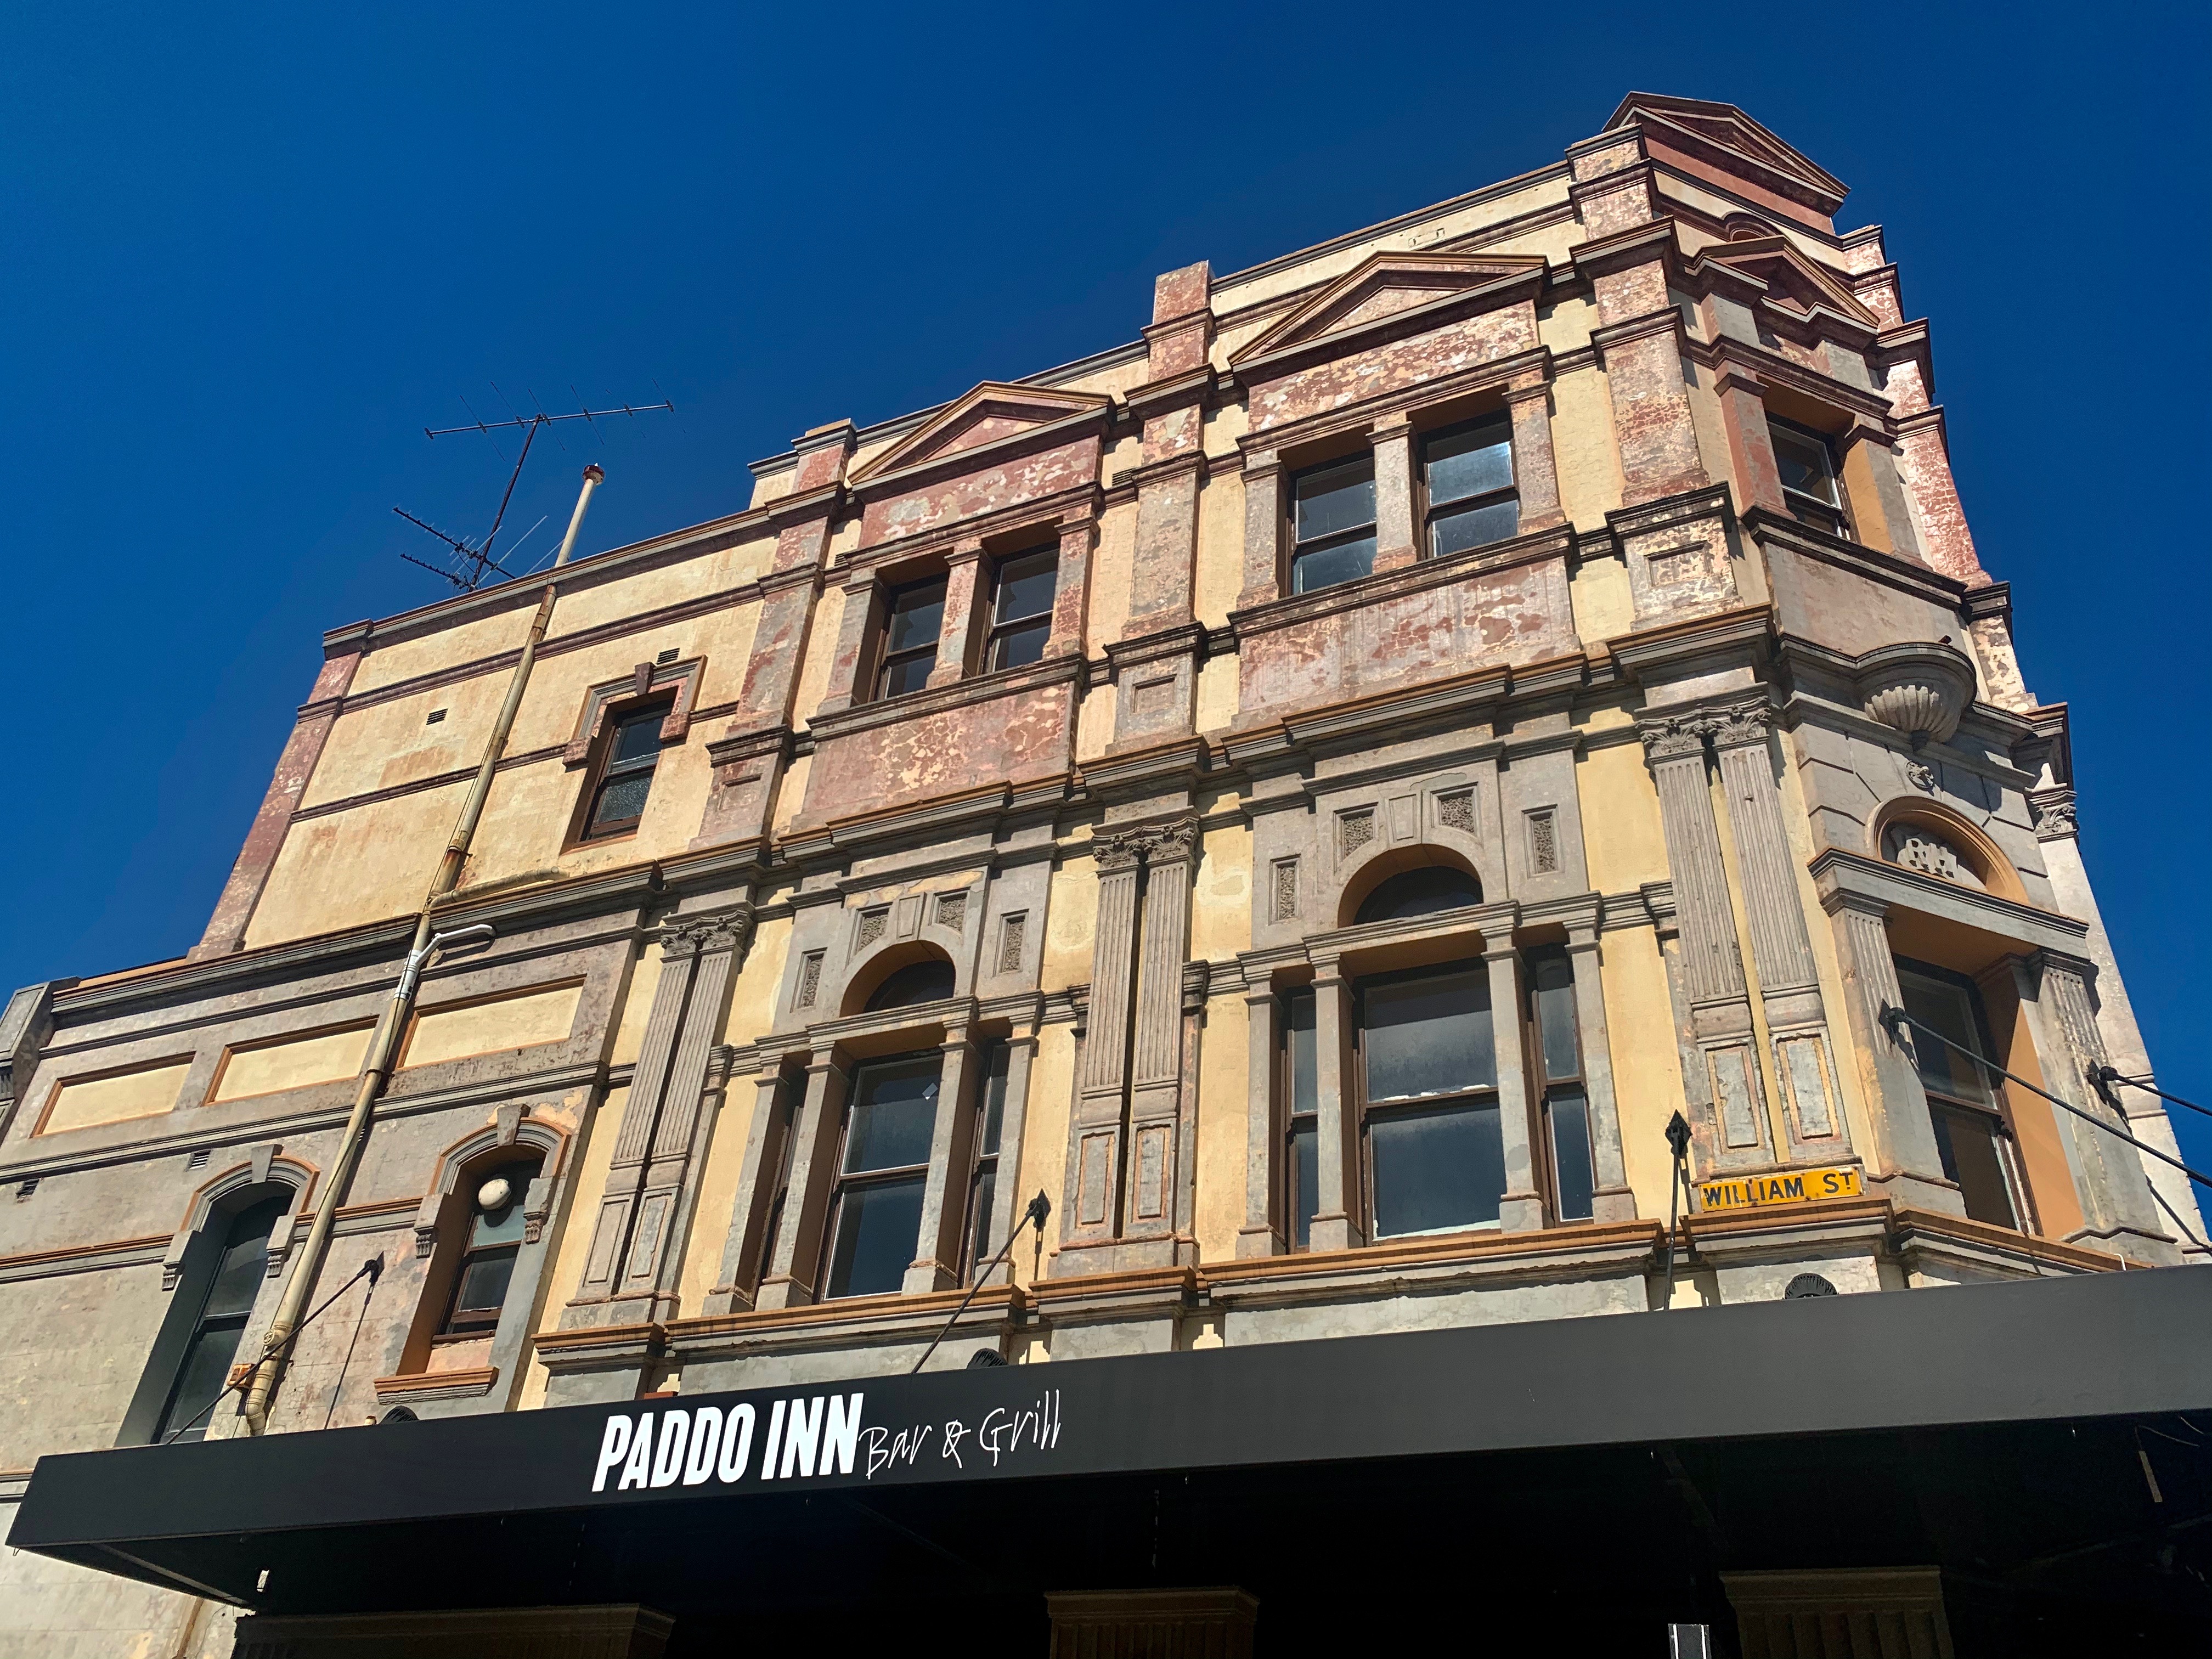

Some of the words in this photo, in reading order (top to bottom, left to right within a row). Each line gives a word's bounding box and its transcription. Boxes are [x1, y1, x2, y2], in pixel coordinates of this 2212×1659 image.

[1703, 1177, 1805, 1207] WILLIAM
[1822, 1172, 1853, 1194] ST
[591, 1403, 755, 1492] PADDO
[760, 1392, 864, 1480] INN
[858, 1425, 933, 1480] Bar
[942, 1419, 972, 1469] &
[979, 1389, 1061, 1467] Grill
